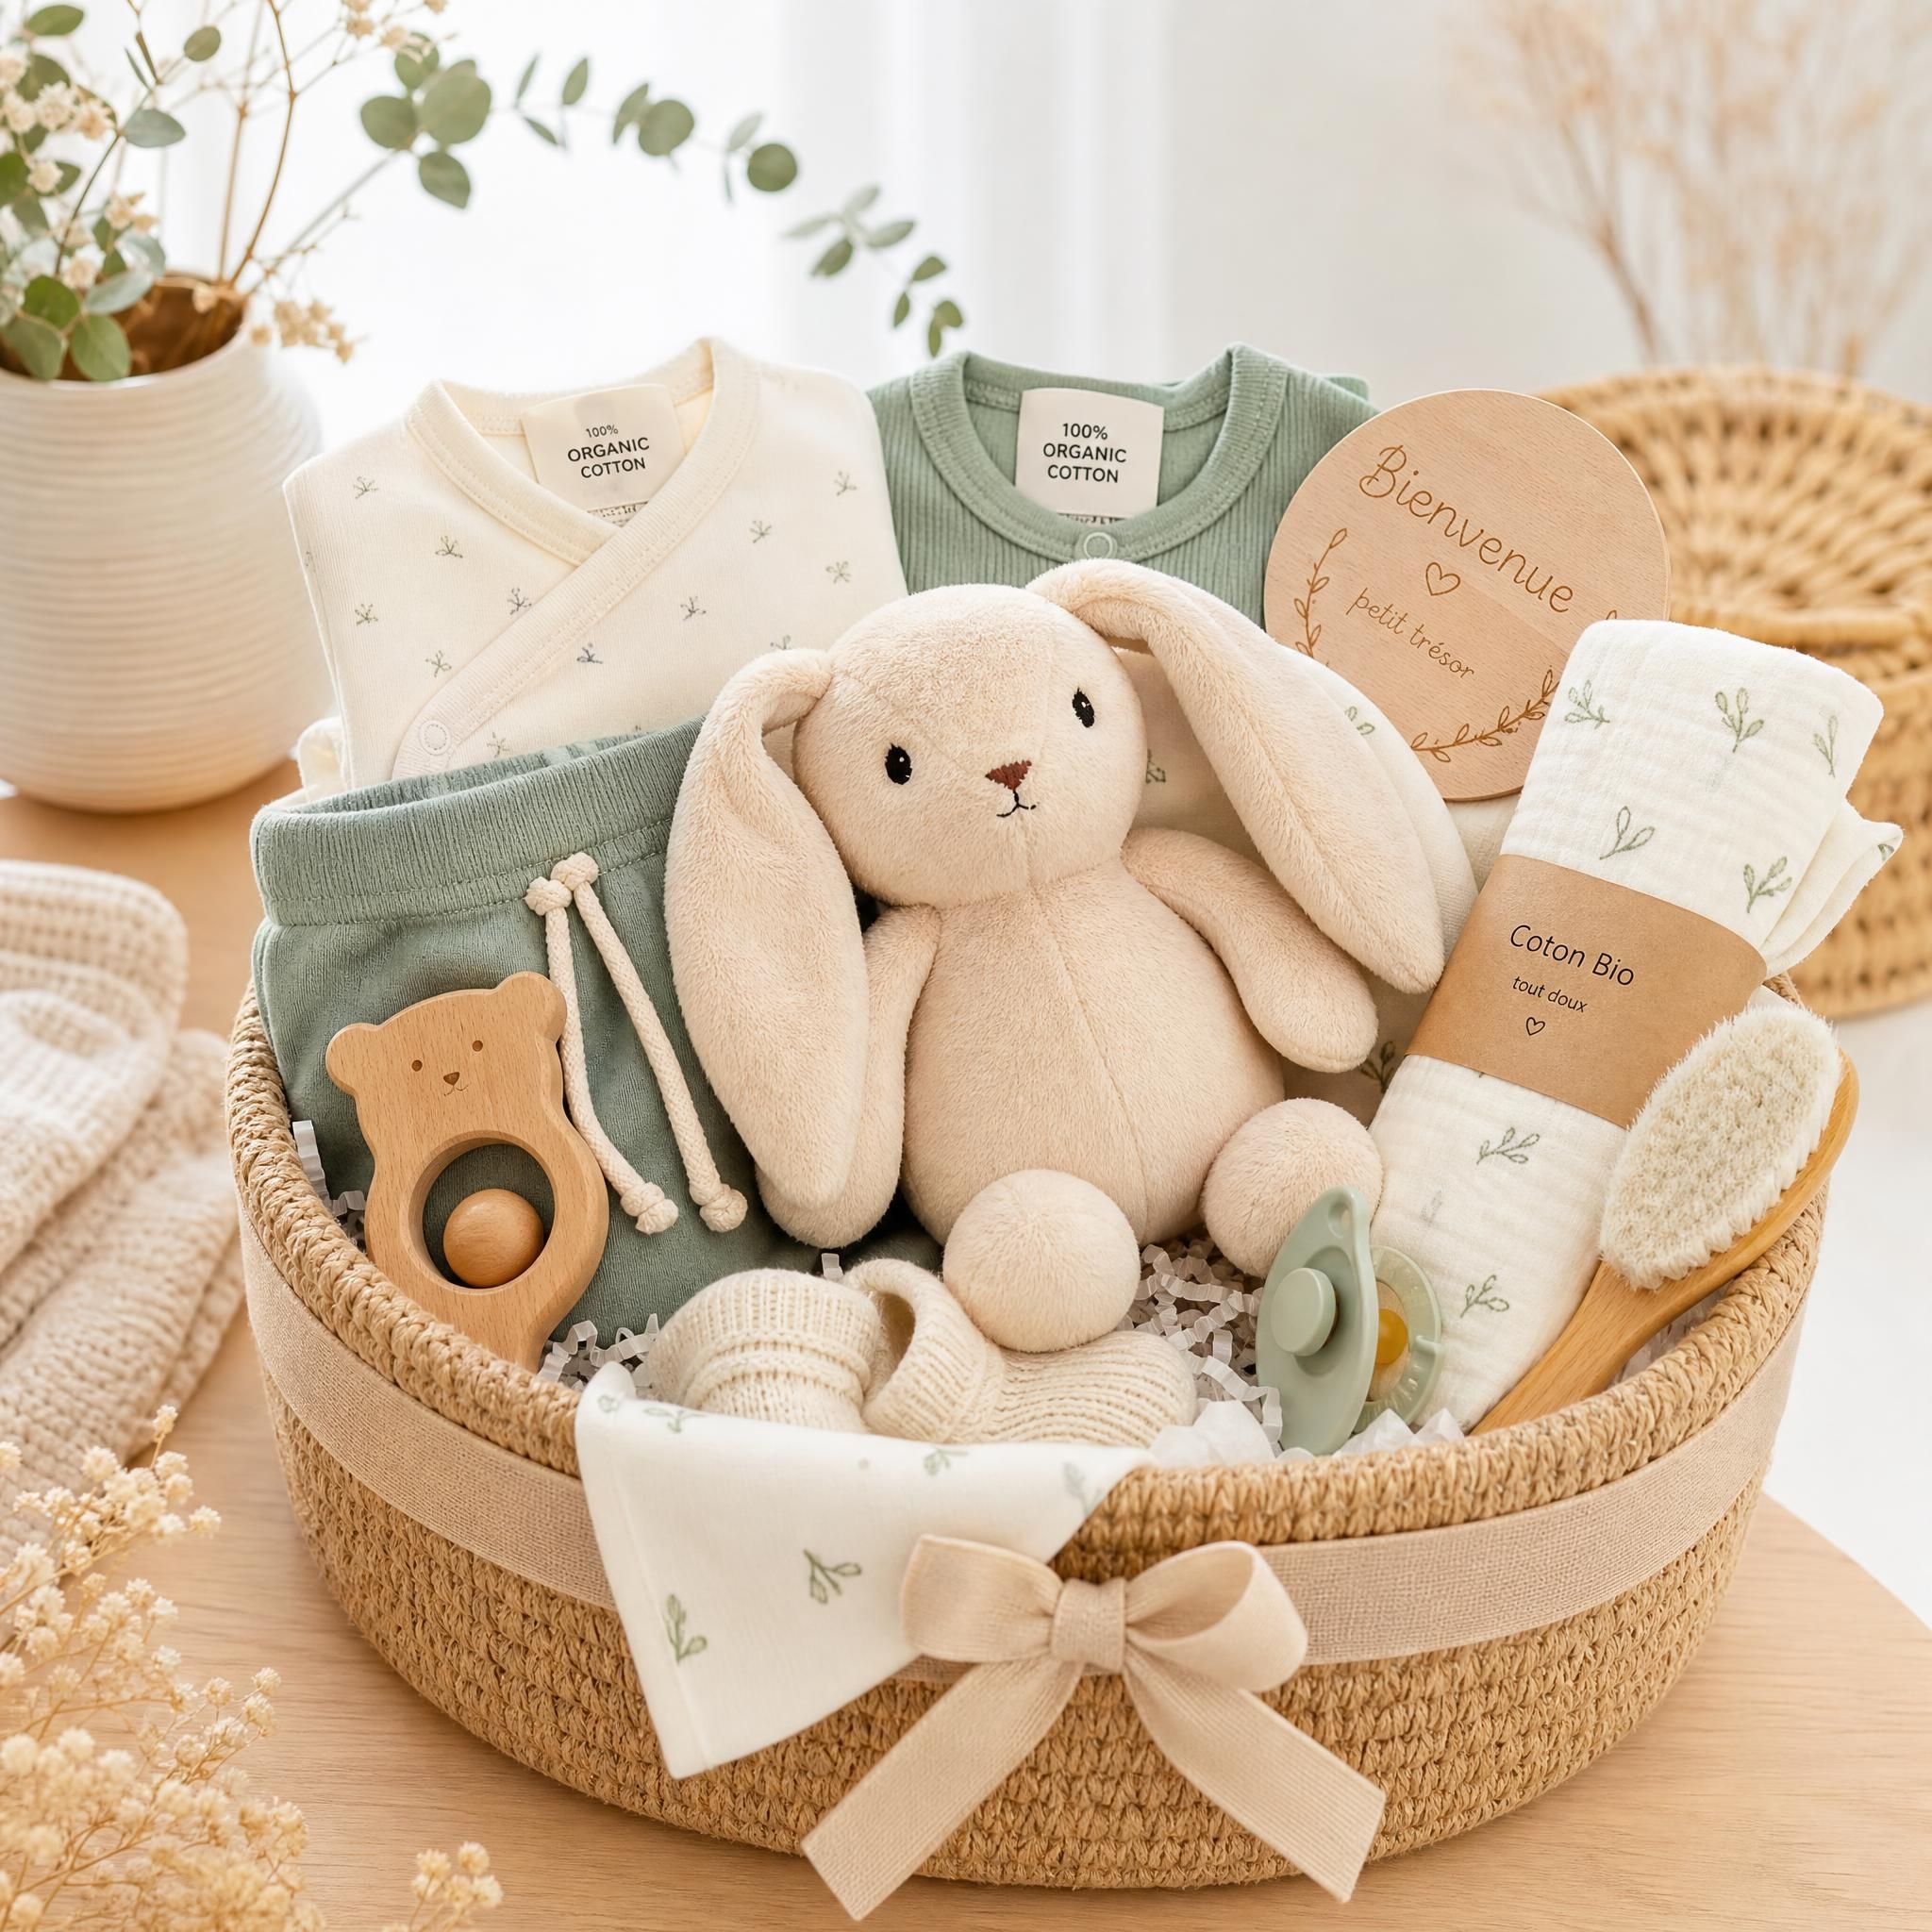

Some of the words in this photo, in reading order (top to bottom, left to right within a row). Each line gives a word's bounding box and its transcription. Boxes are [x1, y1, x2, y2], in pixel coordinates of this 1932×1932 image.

[586, 425, 619, 438] 100%
[1062, 423, 1108, 441] 100%
[567, 437, 650, 462] ORGANIC
[1042, 442, 1127, 463] ORGANIC
[580, 458, 646, 478] COTTON
[1047, 464, 1119, 483] COTTON
[1358, 444, 1574, 613] Bienvenue
[1345, 587, 1407, 636] petit
[1409, 624, 1475, 680] trésor
[1509, 924, 1586, 968] Coton
[1591, 952, 1635, 986] Bio
[1512, 975, 1545, 999] tout
[1547, 989, 1588, 1013] doux
